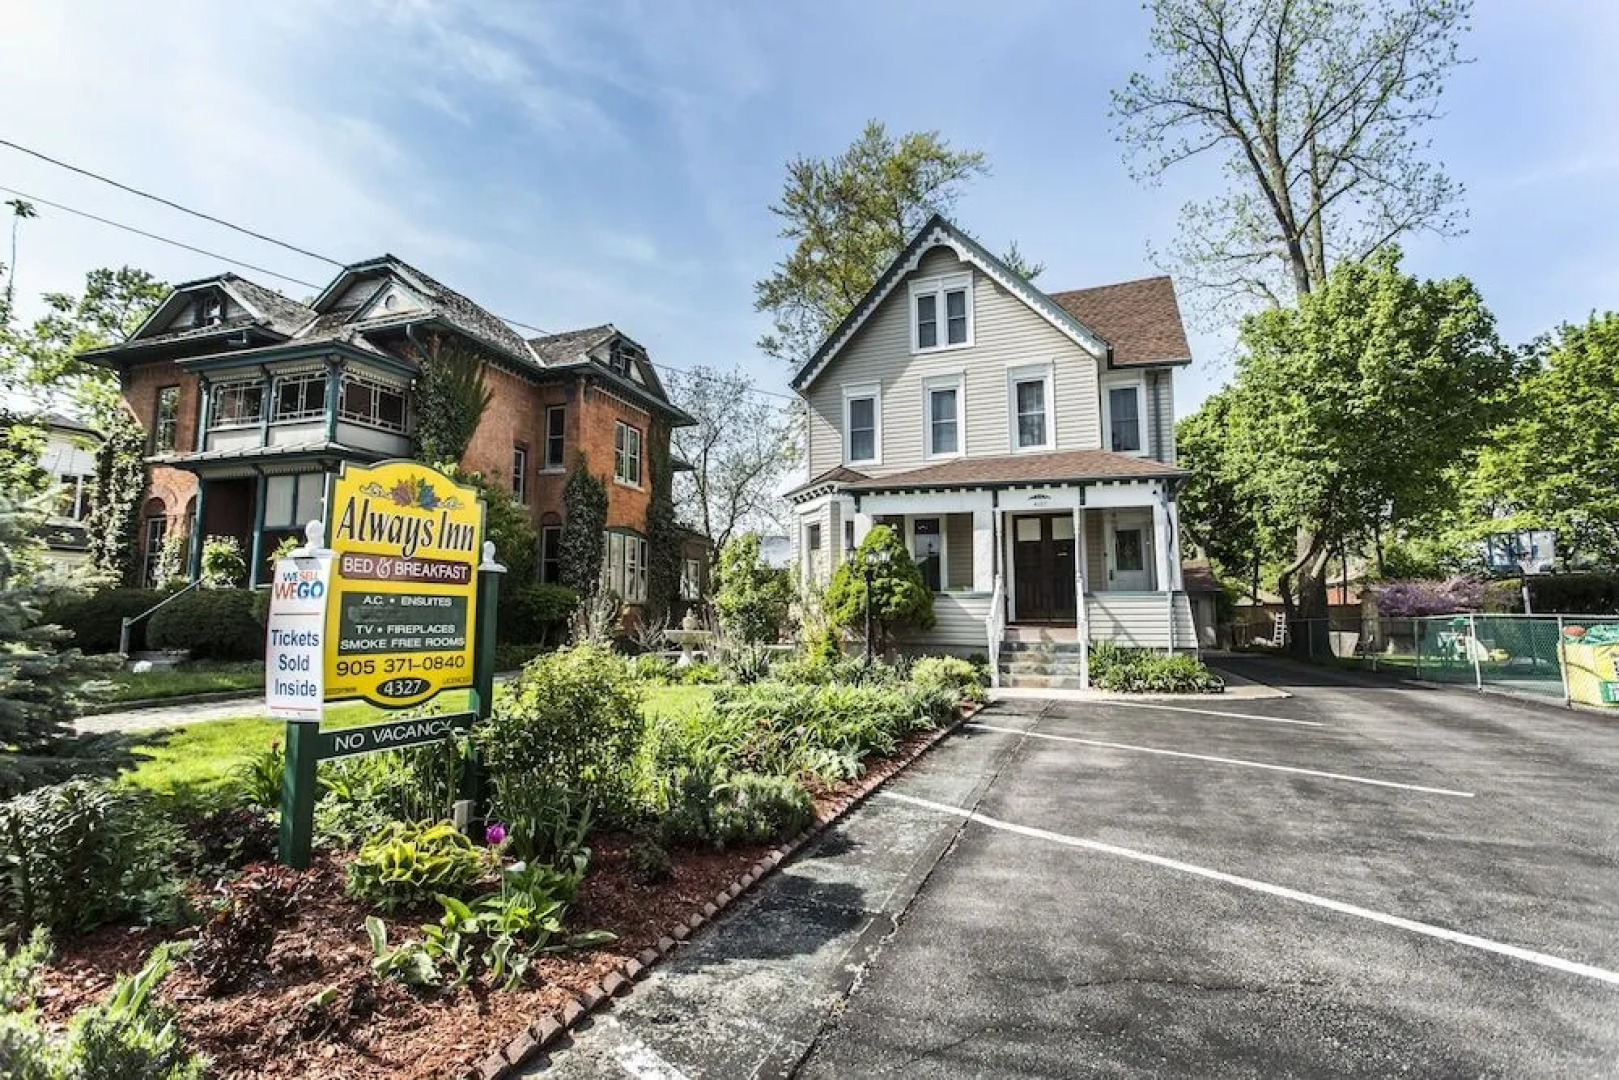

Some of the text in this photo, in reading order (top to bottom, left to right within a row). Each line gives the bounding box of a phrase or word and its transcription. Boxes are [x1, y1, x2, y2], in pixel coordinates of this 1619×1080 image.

[337, 496, 475, 558] Always Inn
[342, 556, 469, 580] BED & BREAKFAST
[400, 596, 453, 608] ENSUITES
[271, 629, 320, 647] Tickets
[355, 624, 456, 635] TV FIREPLACES
[339, 636, 466, 650] SMOKE FREE ROOMS
[278, 653, 310, 672] Sold
[336, 655, 466, 677] 905 371-0840
[274, 678, 318, 698] Inside
[381, 678, 423, 696] 4327
[334, 733, 365, 751] NO
